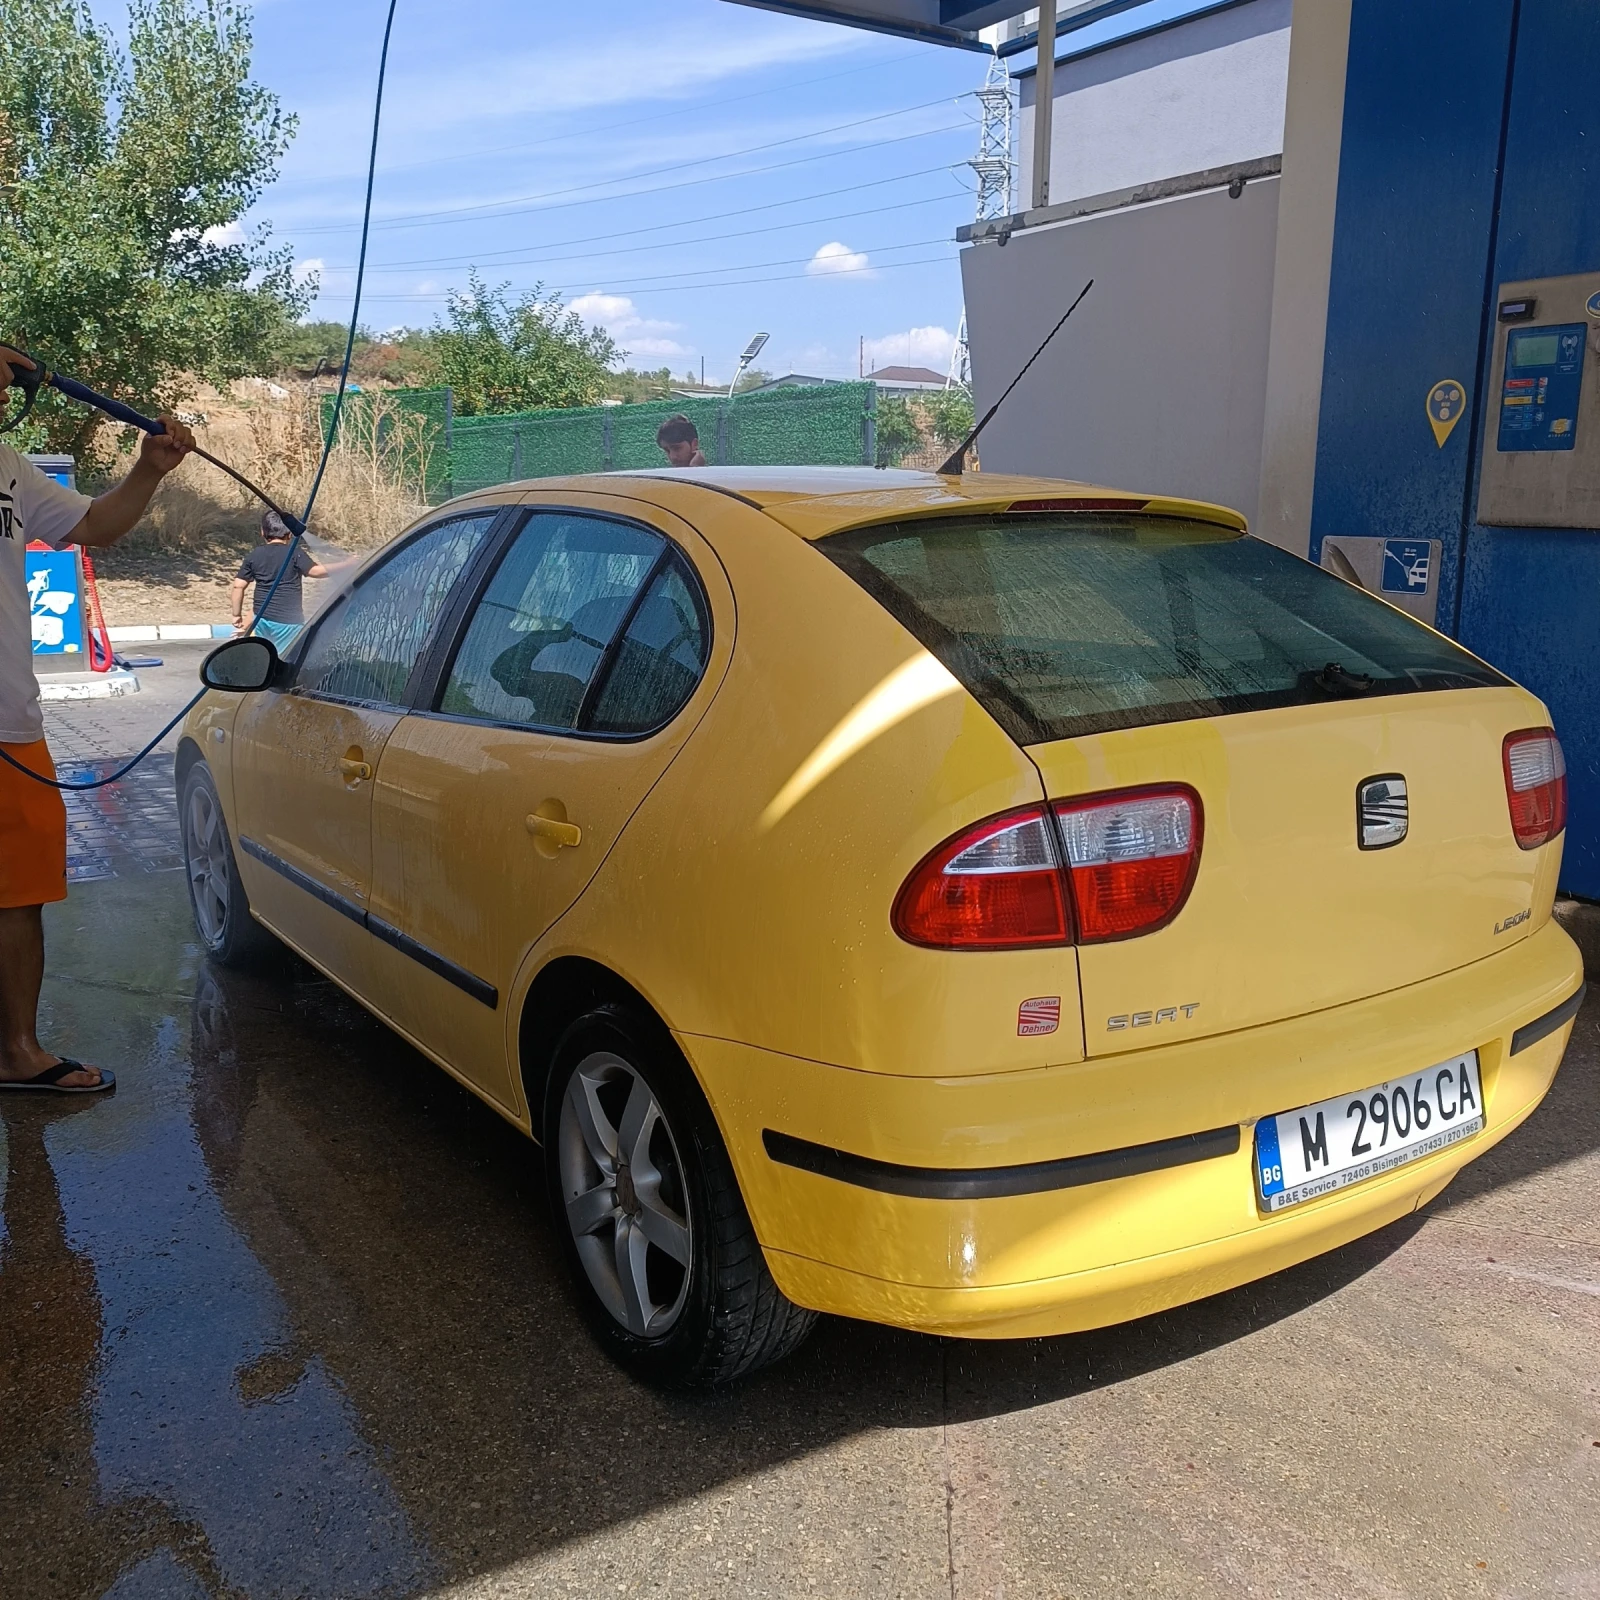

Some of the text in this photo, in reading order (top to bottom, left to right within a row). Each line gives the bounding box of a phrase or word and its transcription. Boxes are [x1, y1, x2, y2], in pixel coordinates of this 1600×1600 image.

[1024, 1000, 1057, 1008] Autohaus
[1021, 1024, 1055, 1034] Dehner
[1107, 1002, 1200, 1032] SEAT
[1299, 1062, 1476, 1172] M 2906 CA
[1263, 1165, 1281, 1185] BG
[1278, 1191, 1299, 1206] B&E
[1302, 1179, 1337, 1198] Service
[1342, 1166, 1370, 1184] 72406
[1372, 1153, 1408, 1173] Bisingen
